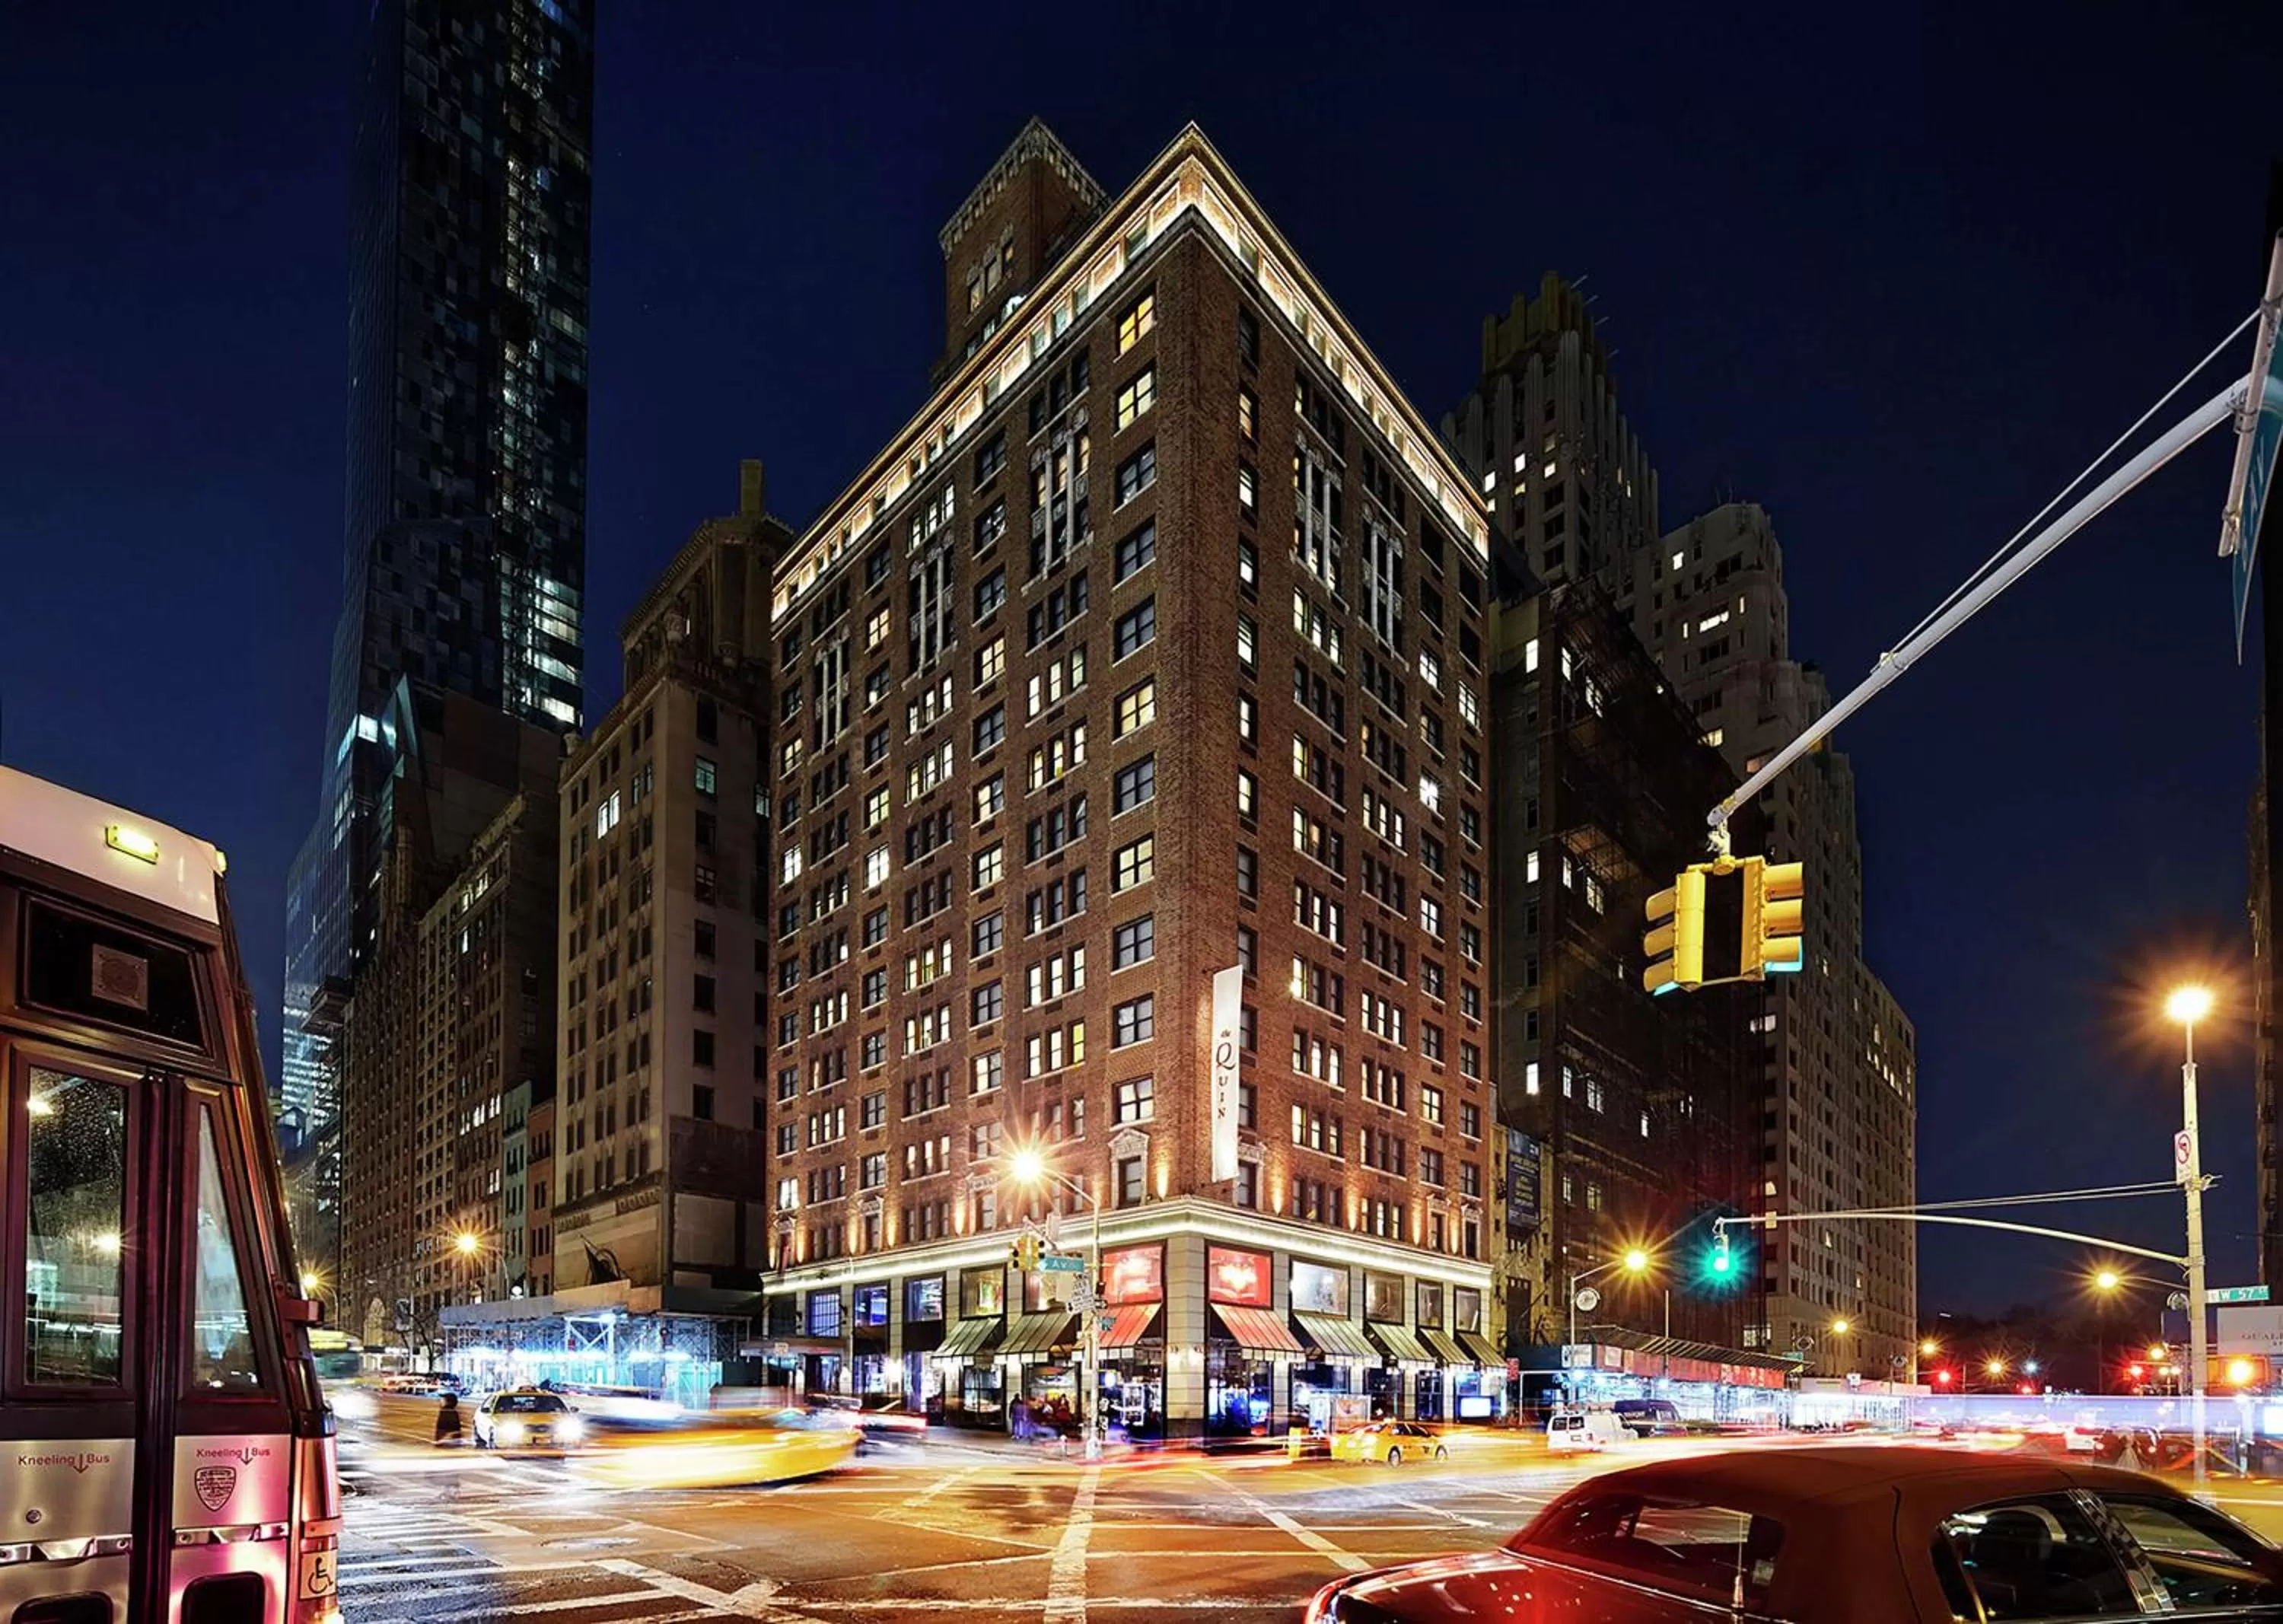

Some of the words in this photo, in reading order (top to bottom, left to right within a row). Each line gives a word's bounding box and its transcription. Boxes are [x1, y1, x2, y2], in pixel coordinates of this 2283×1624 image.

[196, 1448, 243, 1459] Kneeling
[251, 1447, 271, 1457] Bus
[18, 1454, 75, 1466] Kneeling
[86, 1453, 110, 1463] Bus
